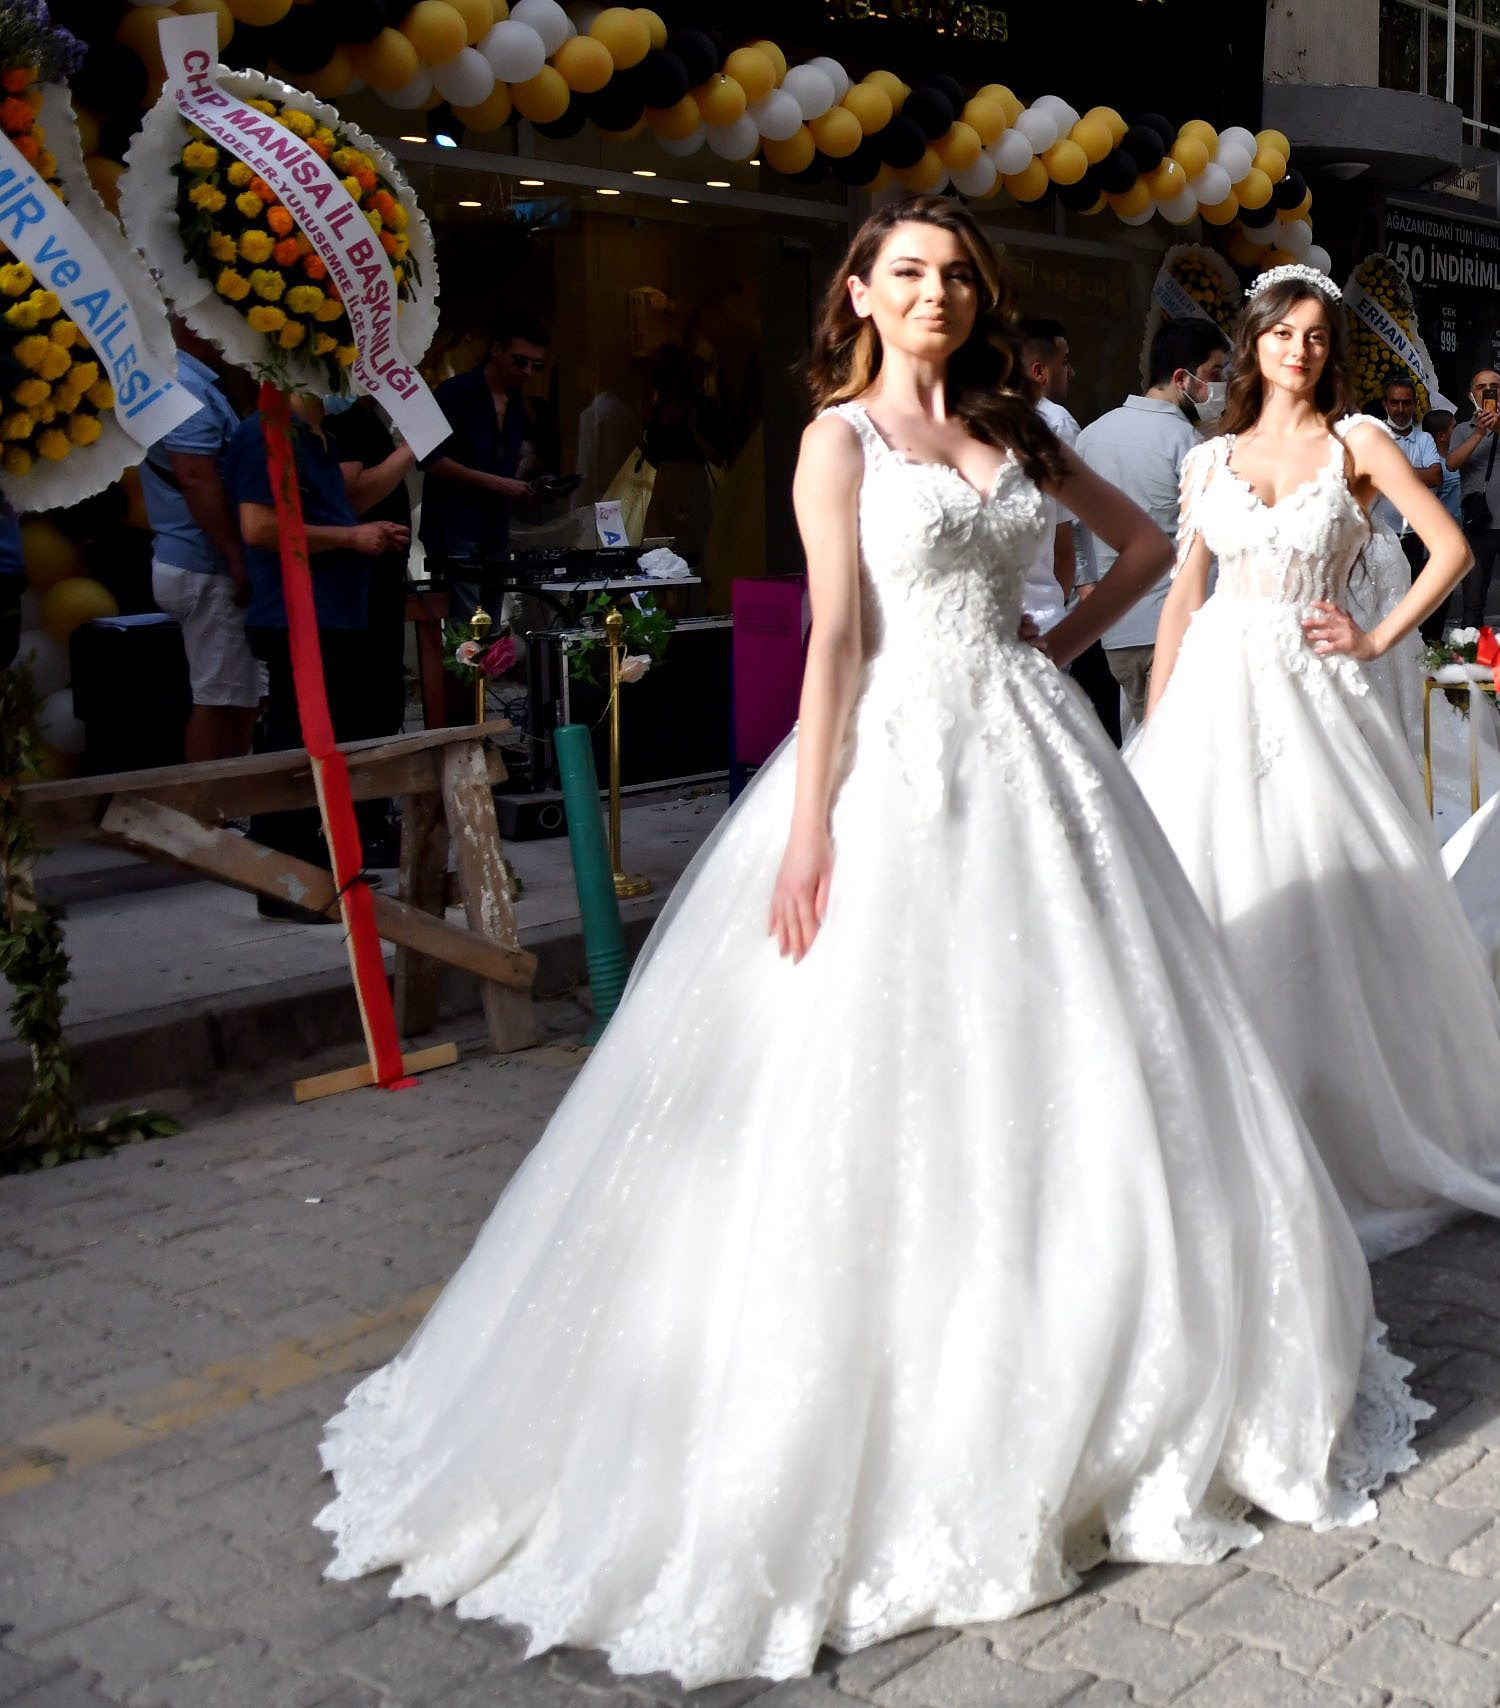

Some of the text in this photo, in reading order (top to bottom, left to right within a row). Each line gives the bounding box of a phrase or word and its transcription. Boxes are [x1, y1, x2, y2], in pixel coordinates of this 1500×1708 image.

[184, 50, 419, 401] CHP MANİSA İL BAŞKANLIĞI
[1454, 224, 1473, 246] TÜM
[1441, 306, 1457, 319] ÇEK
[34, 235, 82, 288] ve
[71, 288, 173, 419] AİLESİ
[1356, 297, 1407, 352] ERHAN
[1442, 319, 1457, 330] YAT
[1440, 330, 1457, 353] 999
